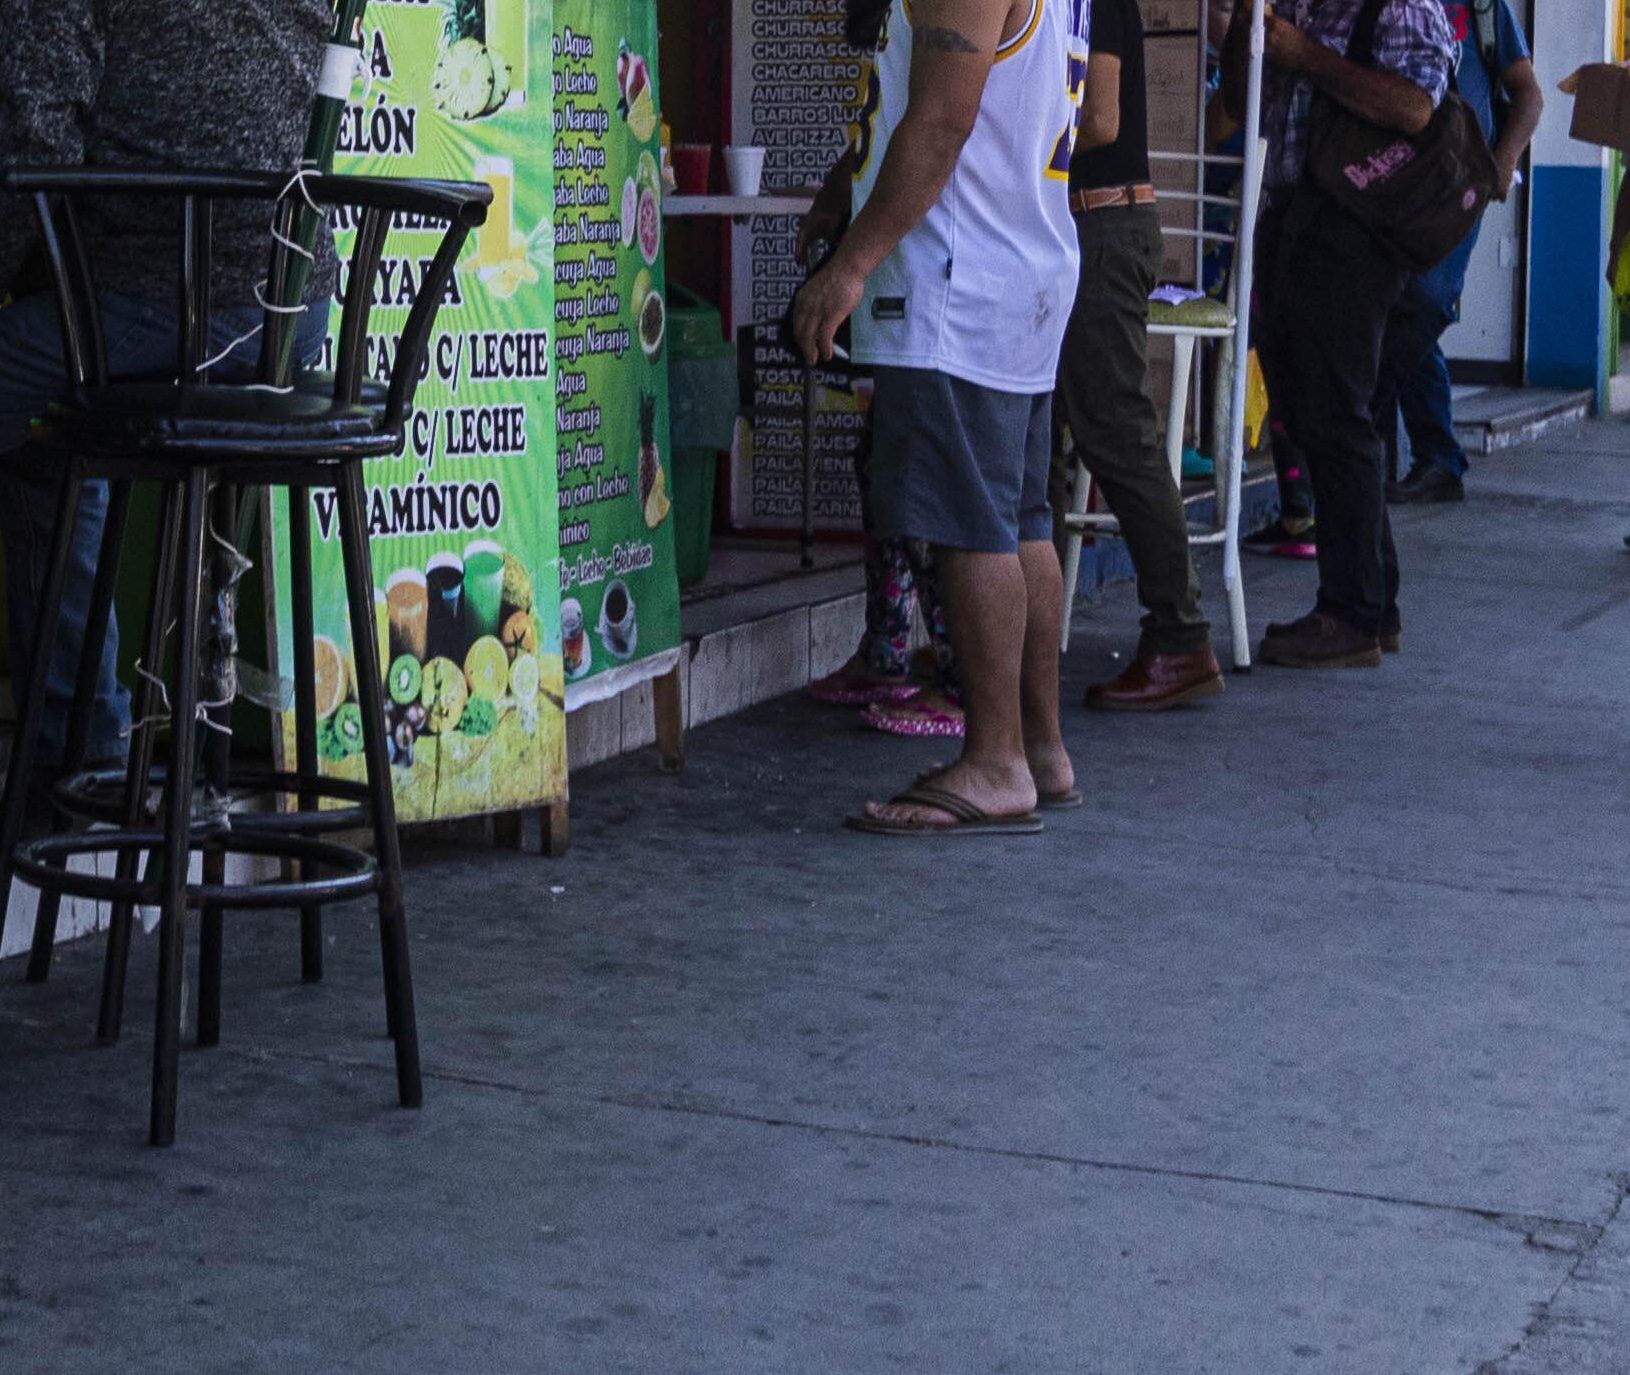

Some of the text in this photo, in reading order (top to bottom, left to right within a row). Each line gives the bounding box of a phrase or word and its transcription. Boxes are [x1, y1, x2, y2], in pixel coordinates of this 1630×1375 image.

[752, 0, 848, 15] CHURRASC
[752, 21, 848, 37] CHURRASC
[563, 27, 593, 62] Agua
[752, 64, 861, 80] CHACARERO
[752, 86, 858, 102] AMERICANO
[336, 94, 416, 154] ELÓN
[564, 101, 610, 141] Naranja
[753, 108, 828, 125] BARROS
[753, 130, 845, 146] AVE PIZZA
[576, 142, 605, 174] Agua
[765, 152, 790, 168] VE
[753, 216, 788, 233] AVE
[753, 239, 788, 255] AVE
[555, 251, 616, 288] cuya Agua
[753, 260, 806, 277] PERN
[555, 299, 583, 326] cuya
[469, 332, 548, 379] LECHE
[555, 337, 583, 363] cuya
[445, 407, 526, 455] LECHE
[313, 470, 502, 539] VAMÍNICO
